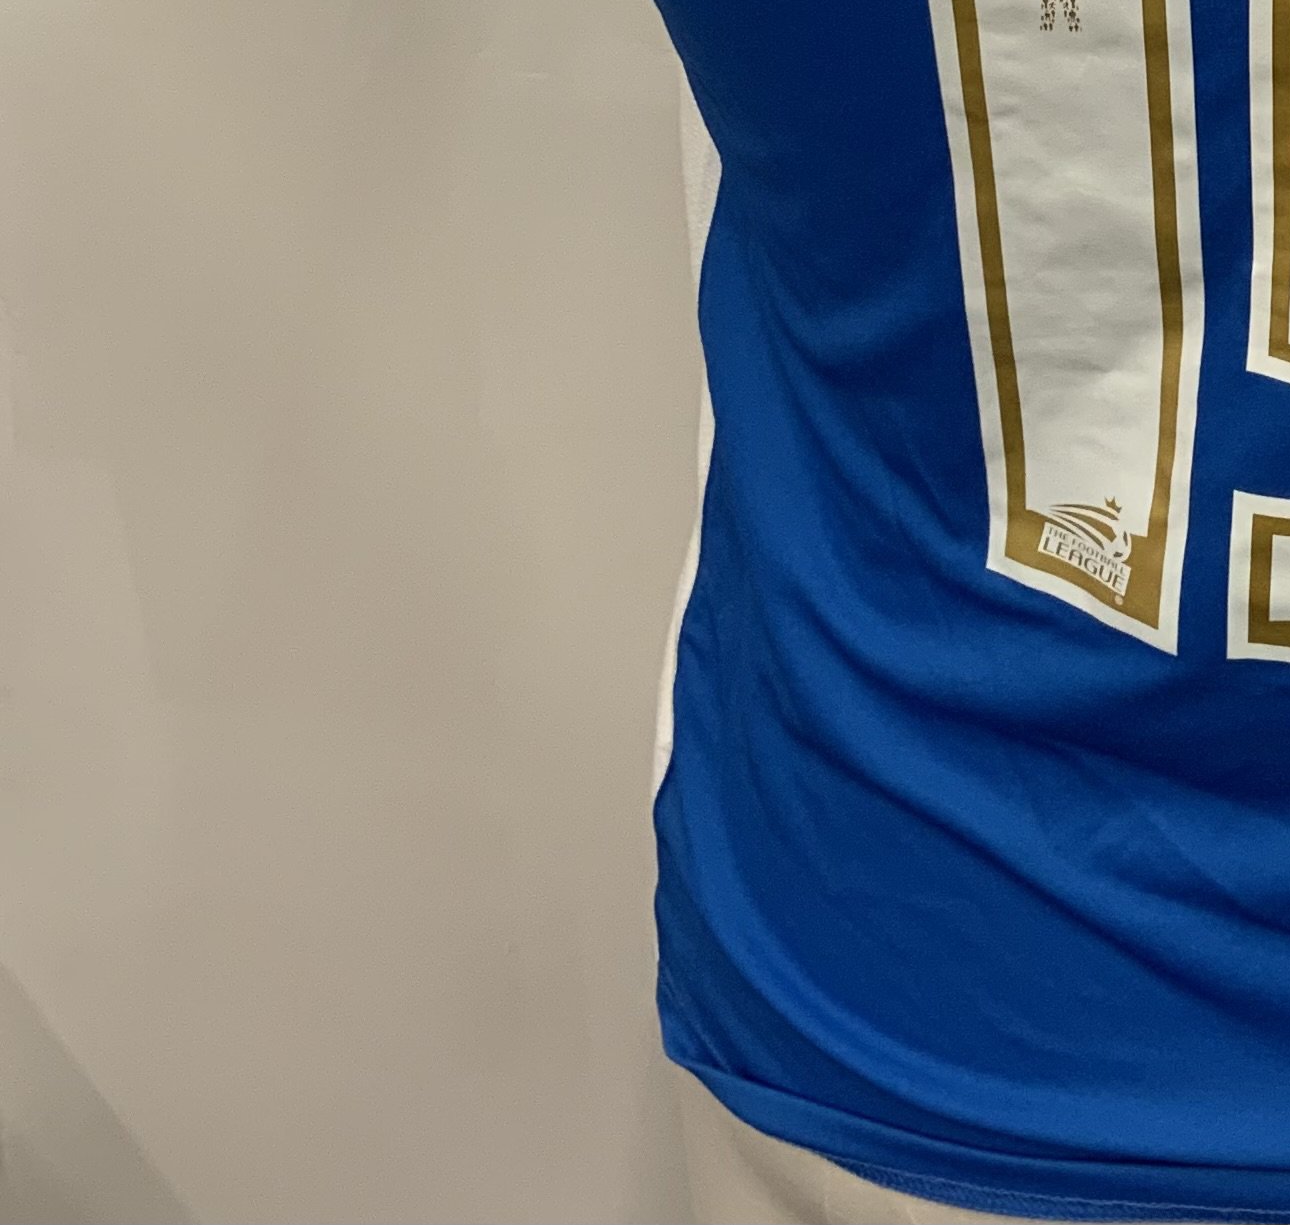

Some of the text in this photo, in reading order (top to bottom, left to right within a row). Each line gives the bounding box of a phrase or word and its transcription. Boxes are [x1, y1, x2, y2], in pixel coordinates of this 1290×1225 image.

[1043, 536, 1125, 594] LEAGUE
[1046, 526, 1126, 577] THE FOOTBALL
